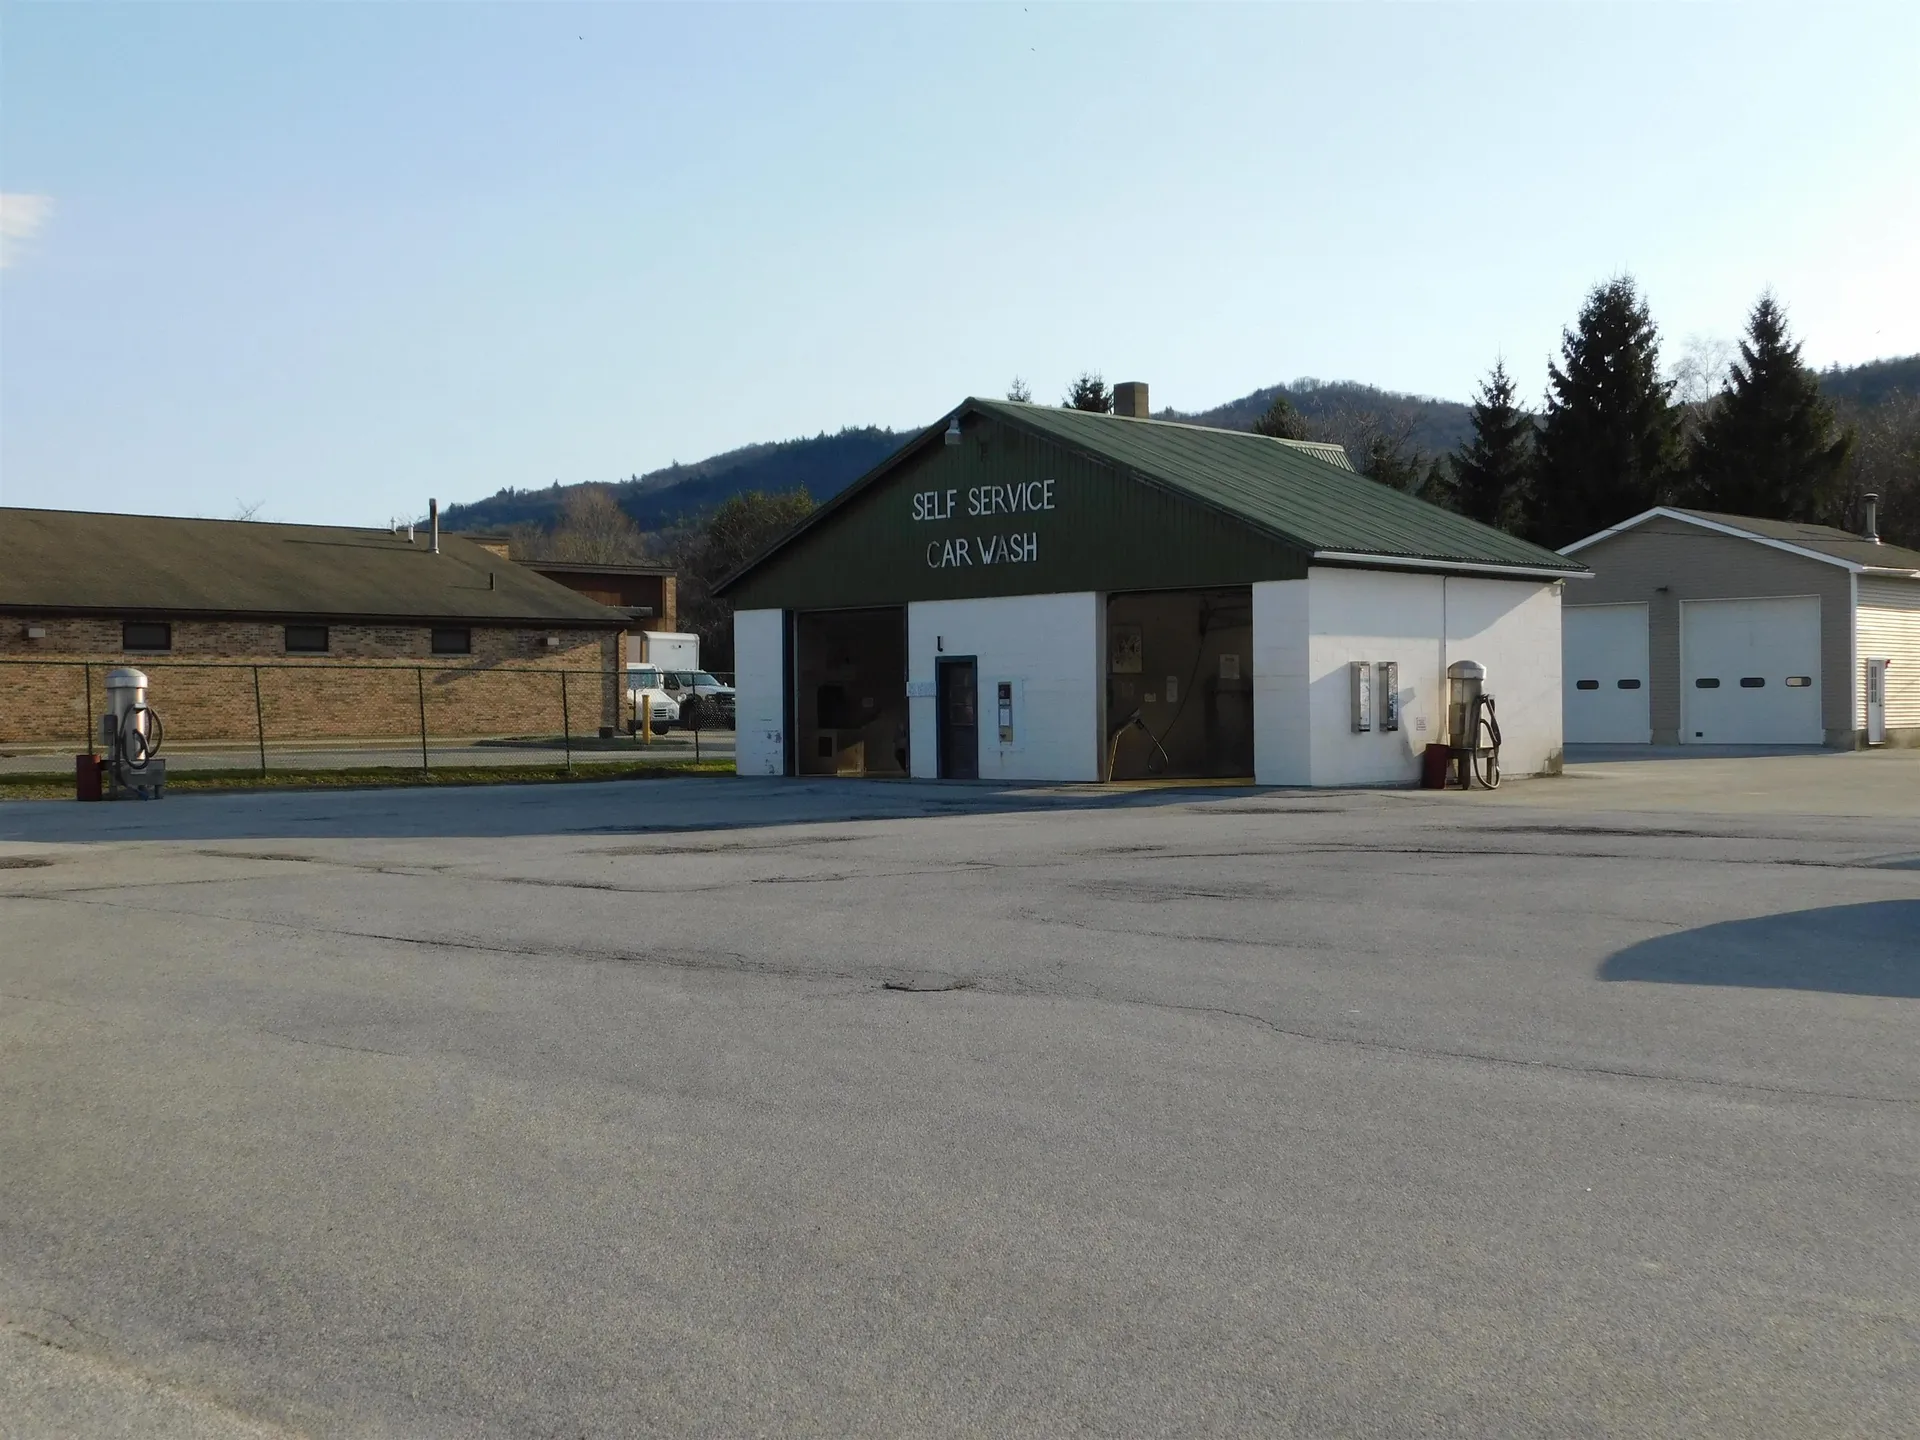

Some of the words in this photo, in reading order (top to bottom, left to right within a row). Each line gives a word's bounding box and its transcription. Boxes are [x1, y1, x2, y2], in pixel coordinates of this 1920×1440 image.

[912, 489, 957, 520] SELF
[968, 479, 1055, 516] SERVICE
[926, 538, 973, 568] CAR
[977, 532, 1037, 565] WASH
